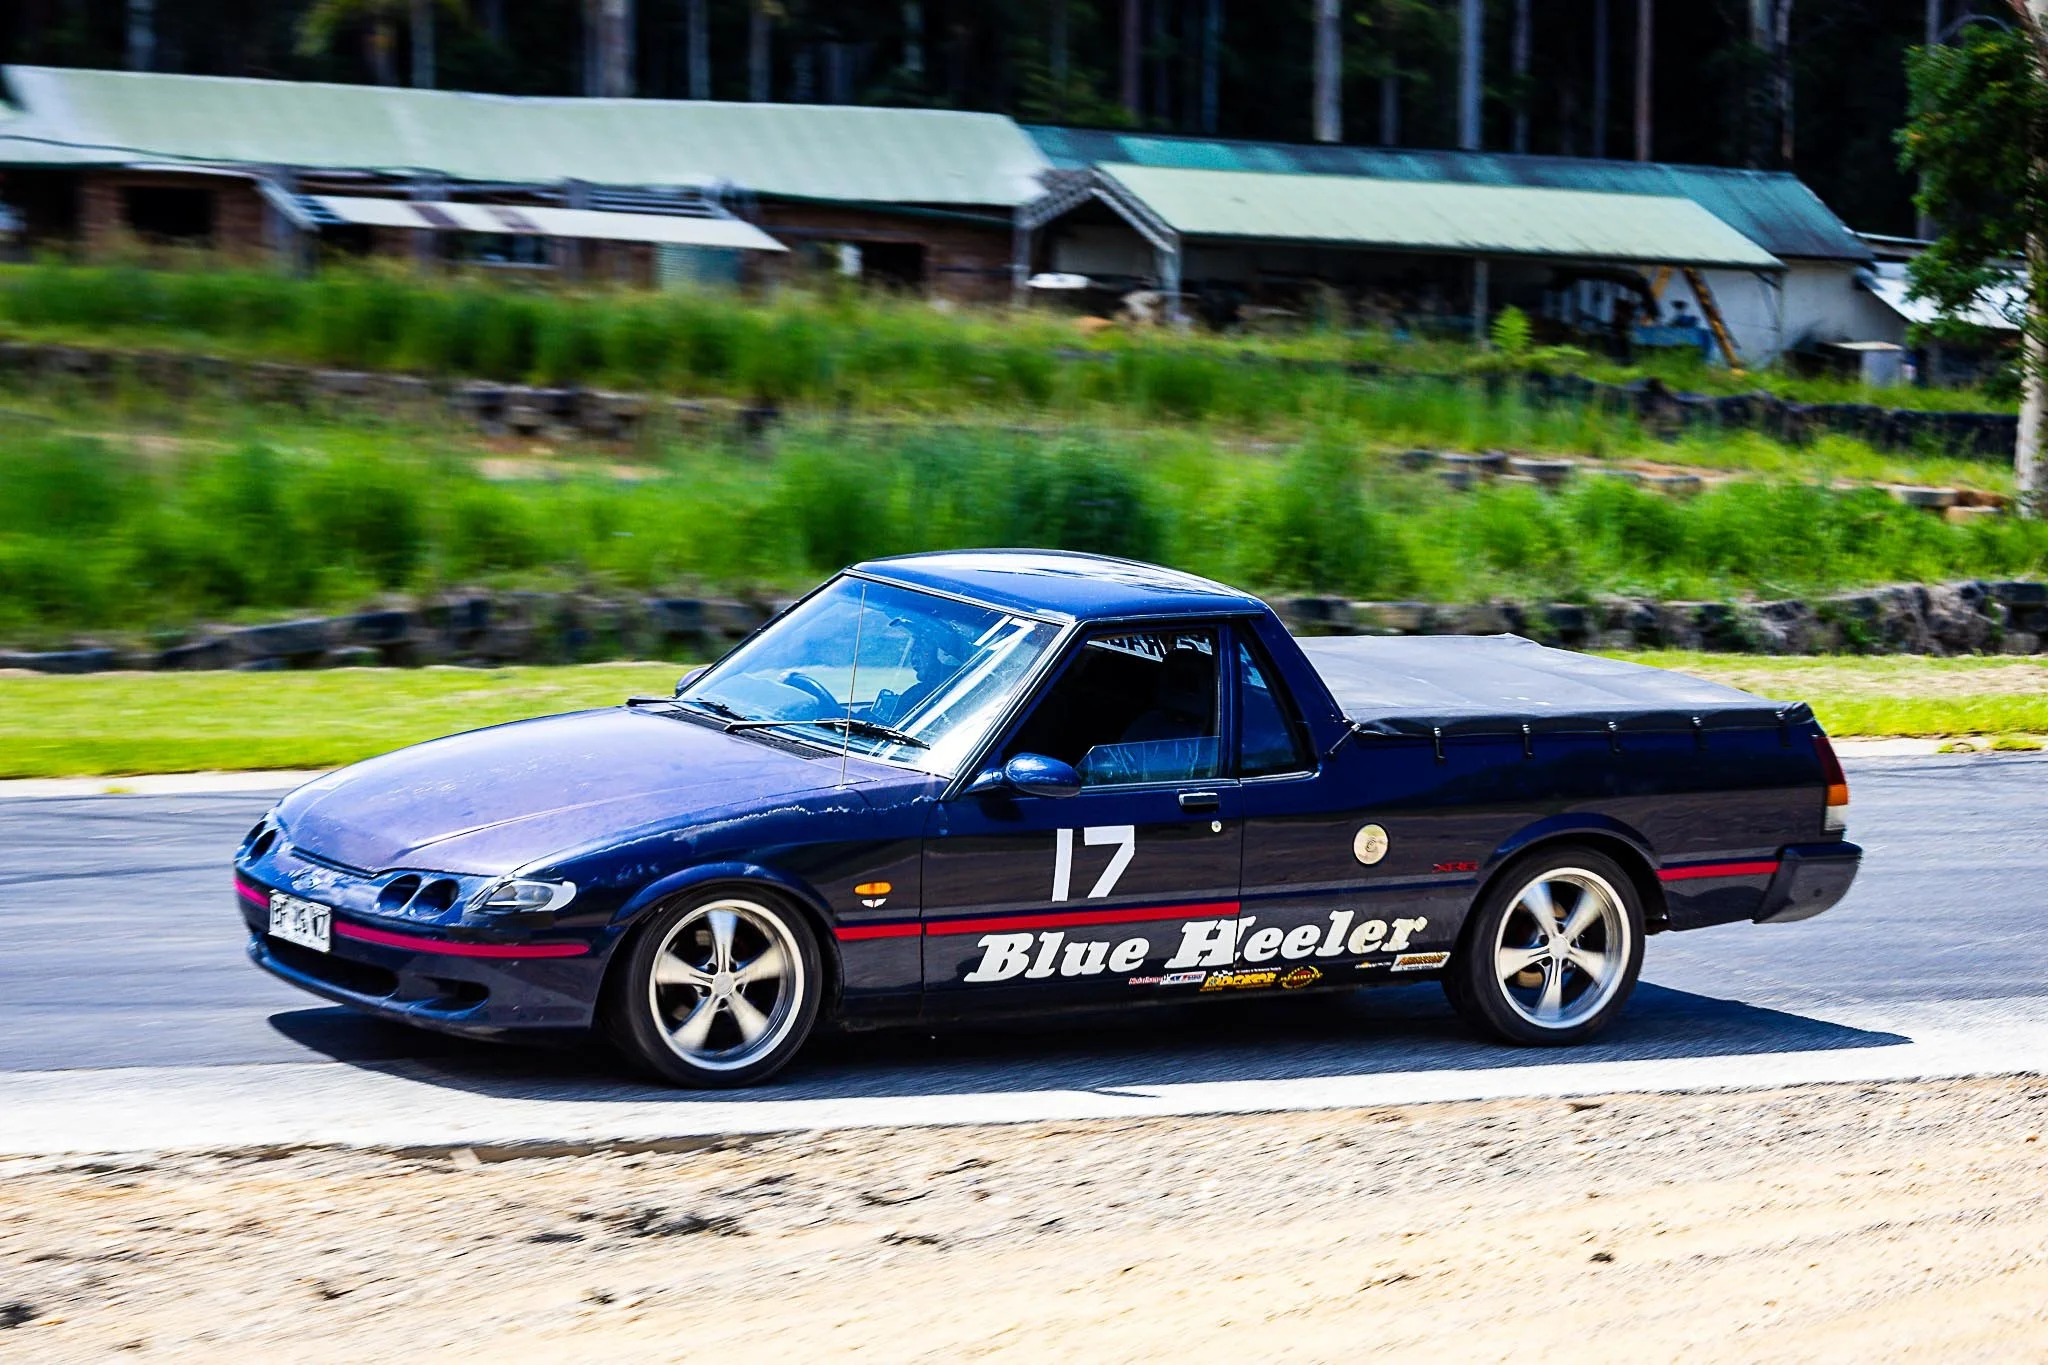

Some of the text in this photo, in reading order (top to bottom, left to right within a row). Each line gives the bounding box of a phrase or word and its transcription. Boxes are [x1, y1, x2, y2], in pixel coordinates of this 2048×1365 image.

[1051, 825, 1136, 902] 17
[963, 910, 1428, 982] Blue Heeler
